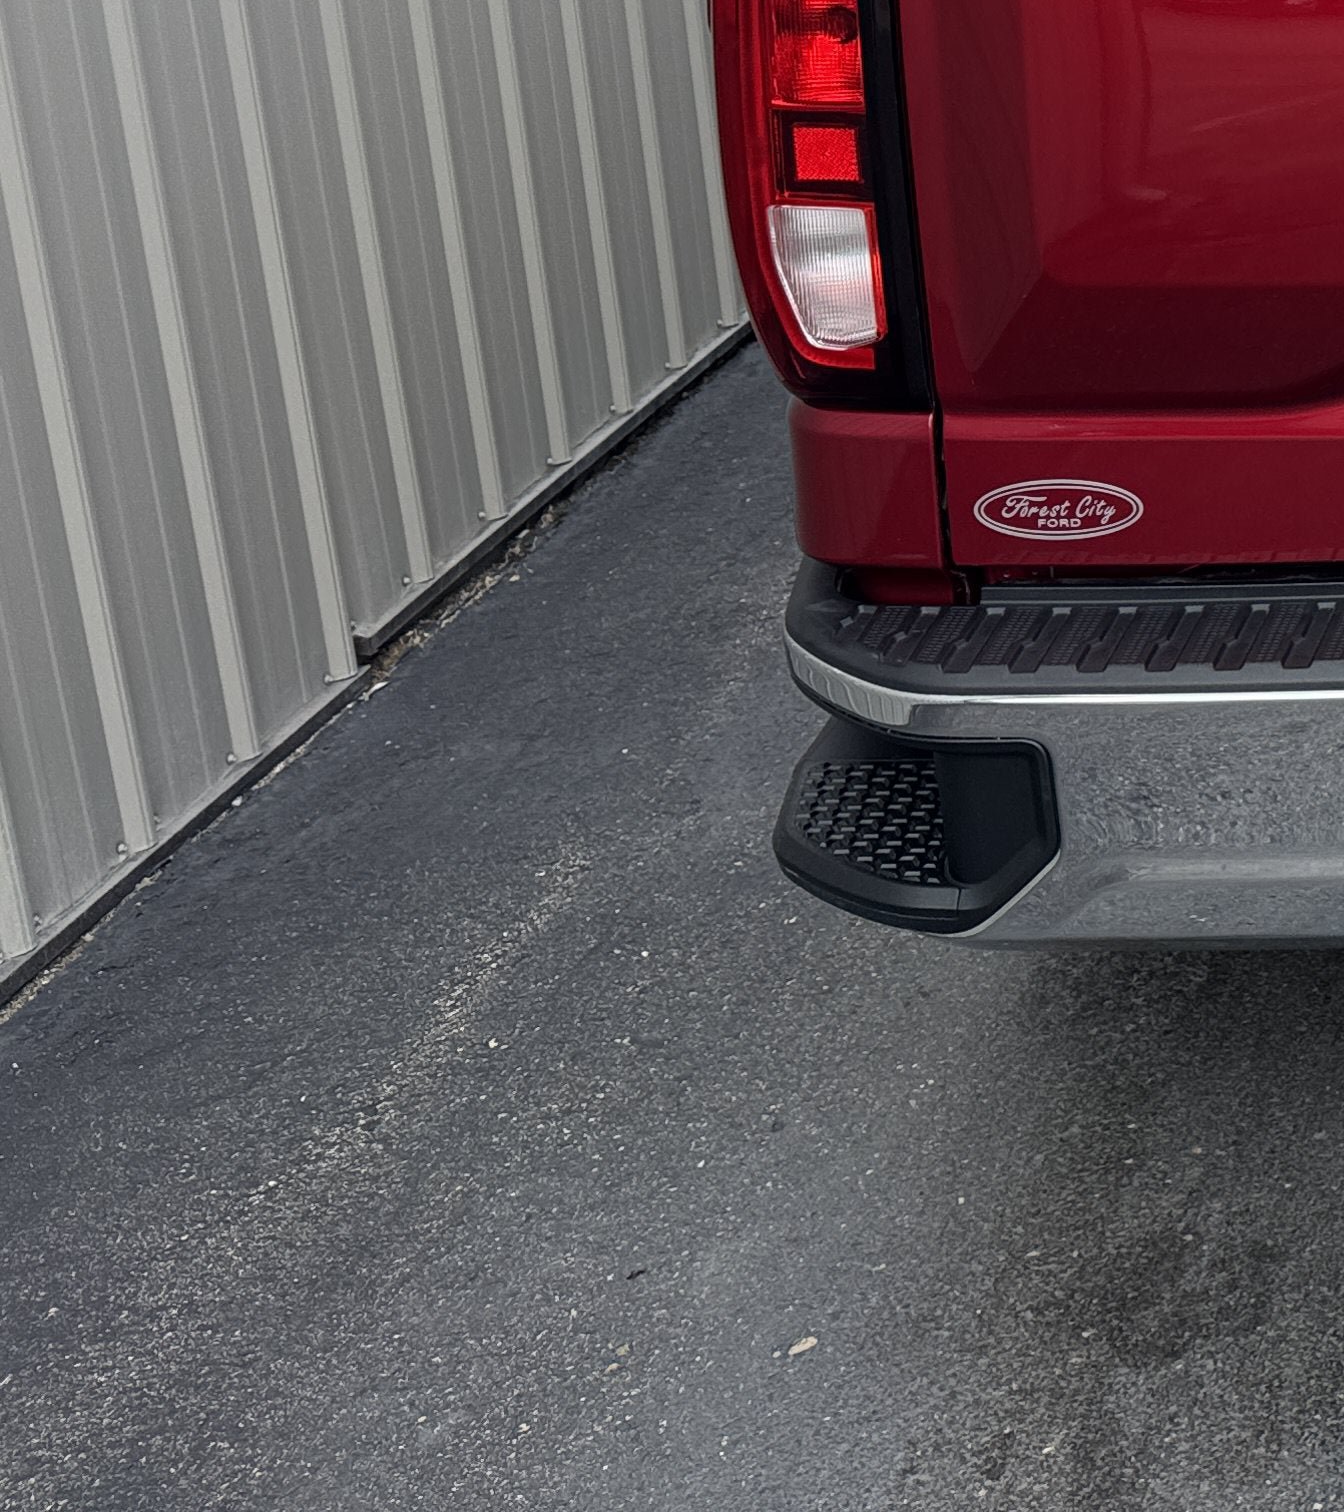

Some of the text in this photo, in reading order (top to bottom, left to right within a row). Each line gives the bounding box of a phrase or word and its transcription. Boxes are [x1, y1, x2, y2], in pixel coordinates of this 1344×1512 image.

[1001, 495, 1116, 525] Forest City
[1037, 518, 1082, 529] FORD
